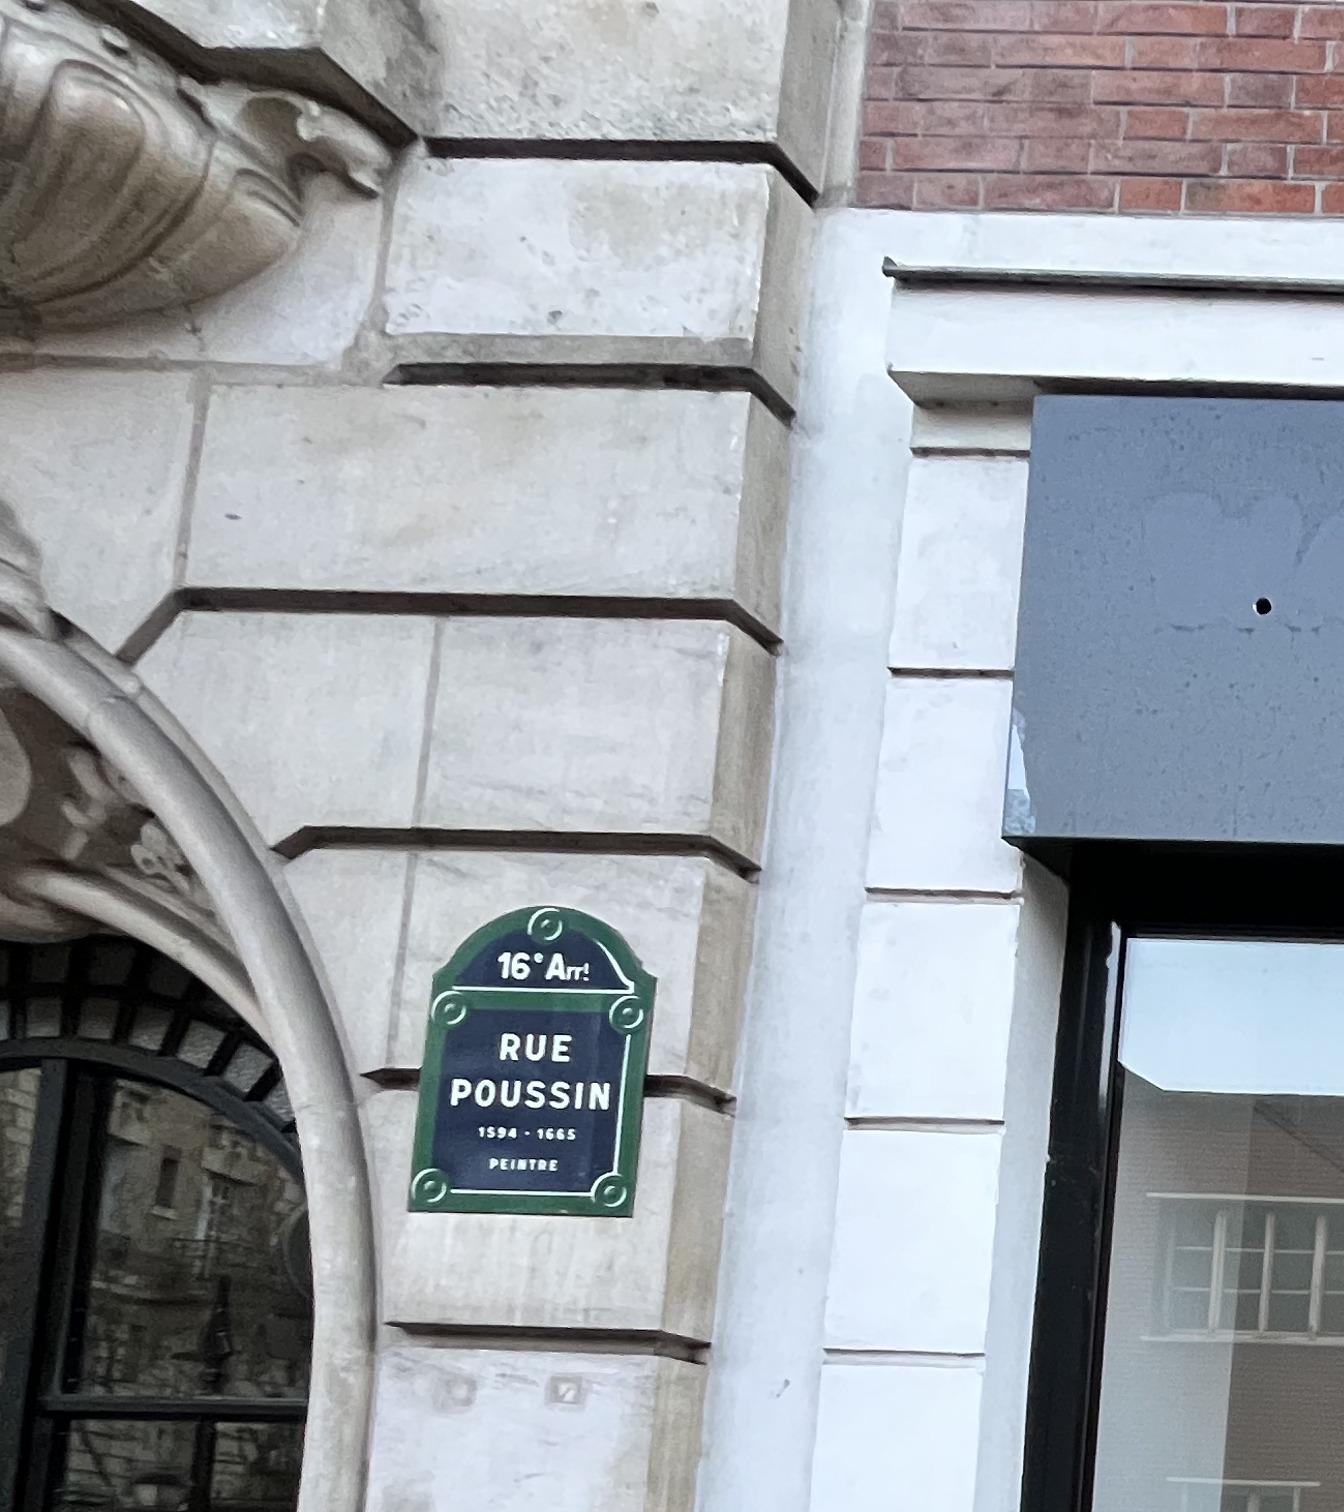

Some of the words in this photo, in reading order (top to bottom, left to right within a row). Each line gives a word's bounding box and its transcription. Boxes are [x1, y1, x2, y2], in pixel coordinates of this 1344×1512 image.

[499, 1032, 573, 1063] RUE
[449, 1077, 611, 1112] POUSSIN
[477, 1125, 518, 1140] 1594
[536, 1127, 577, 1142] 1665
[488, 1157, 559, 1173] PEINTRE
